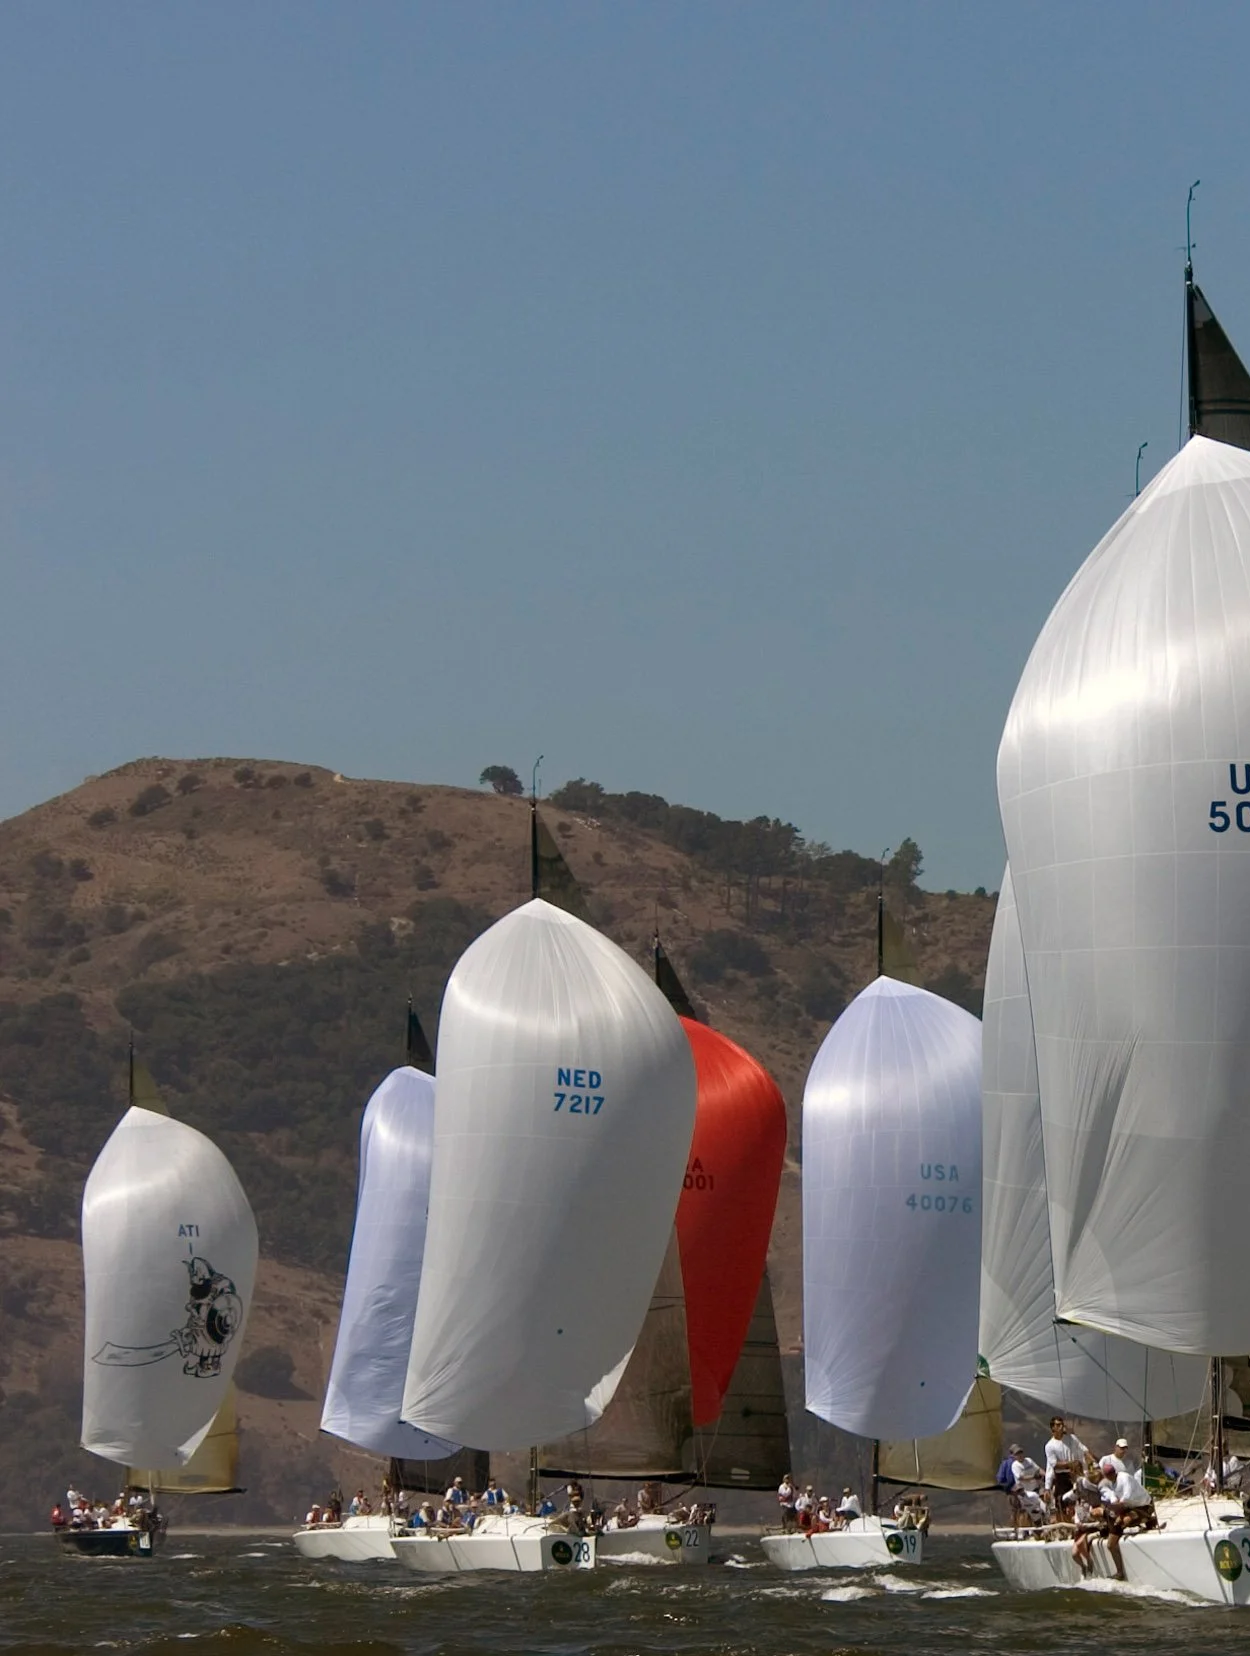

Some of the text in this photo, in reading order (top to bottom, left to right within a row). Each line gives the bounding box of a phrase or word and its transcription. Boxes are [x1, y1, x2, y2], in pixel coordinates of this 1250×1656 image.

[557, 1068, 602, 1089] NED
[553, 1092, 605, 1115] 7217
[683, 1174, 715, 1191] 001
[920, 1163, 959, 1182] USA
[905, 1192, 973, 1214] 40076
[685, 1529, 699, 1547] 22
[904, 1535, 916, 1553] 19
[573, 1541, 590, 1562] 28
